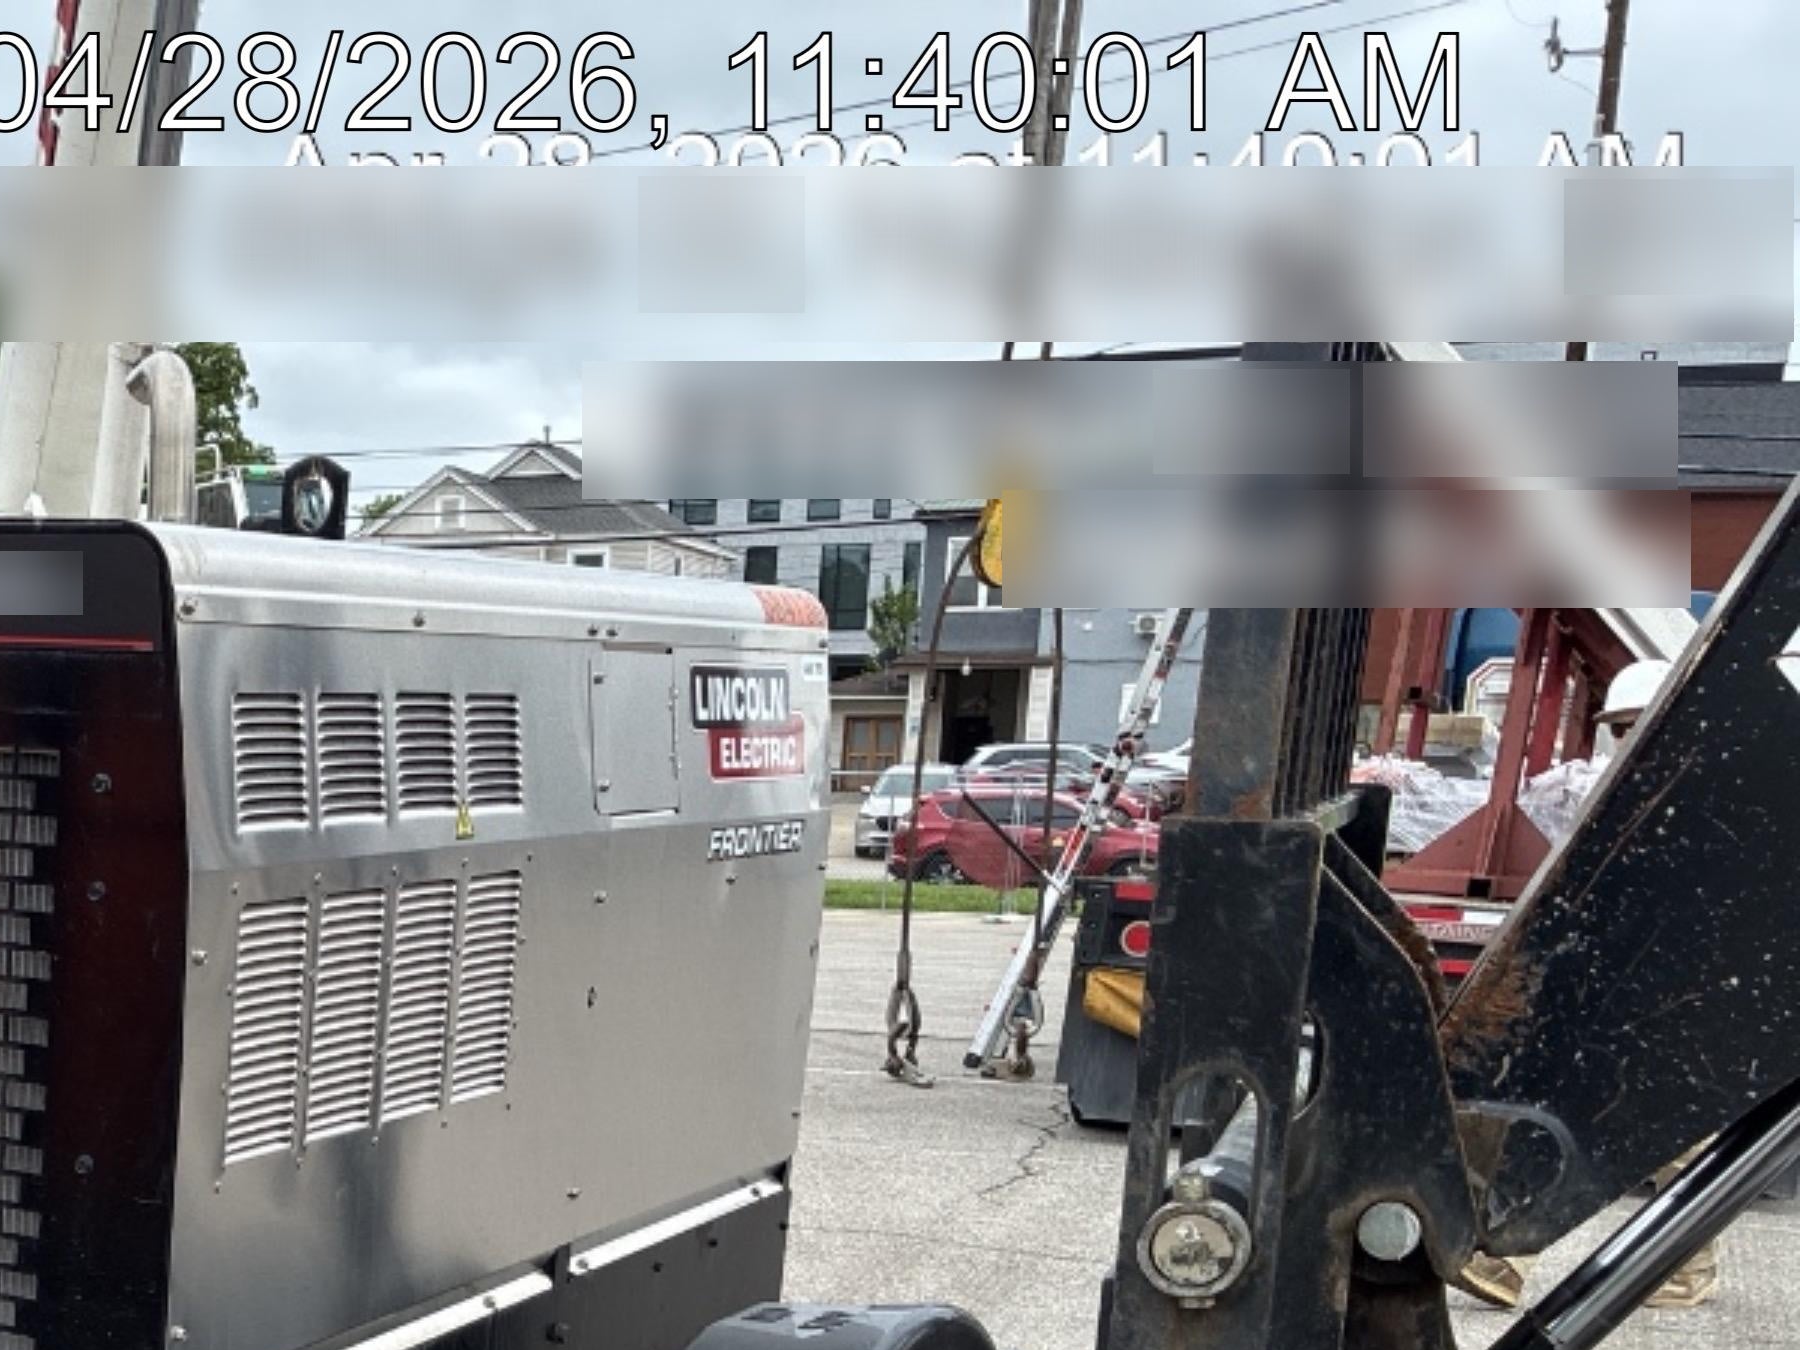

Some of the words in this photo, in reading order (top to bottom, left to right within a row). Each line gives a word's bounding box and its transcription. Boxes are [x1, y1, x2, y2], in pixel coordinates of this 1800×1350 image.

[695, 677, 786, 722] LINCOLN
[719, 735, 797, 770] ELECTRIC
[707, 819, 804, 861] FRONTIER
